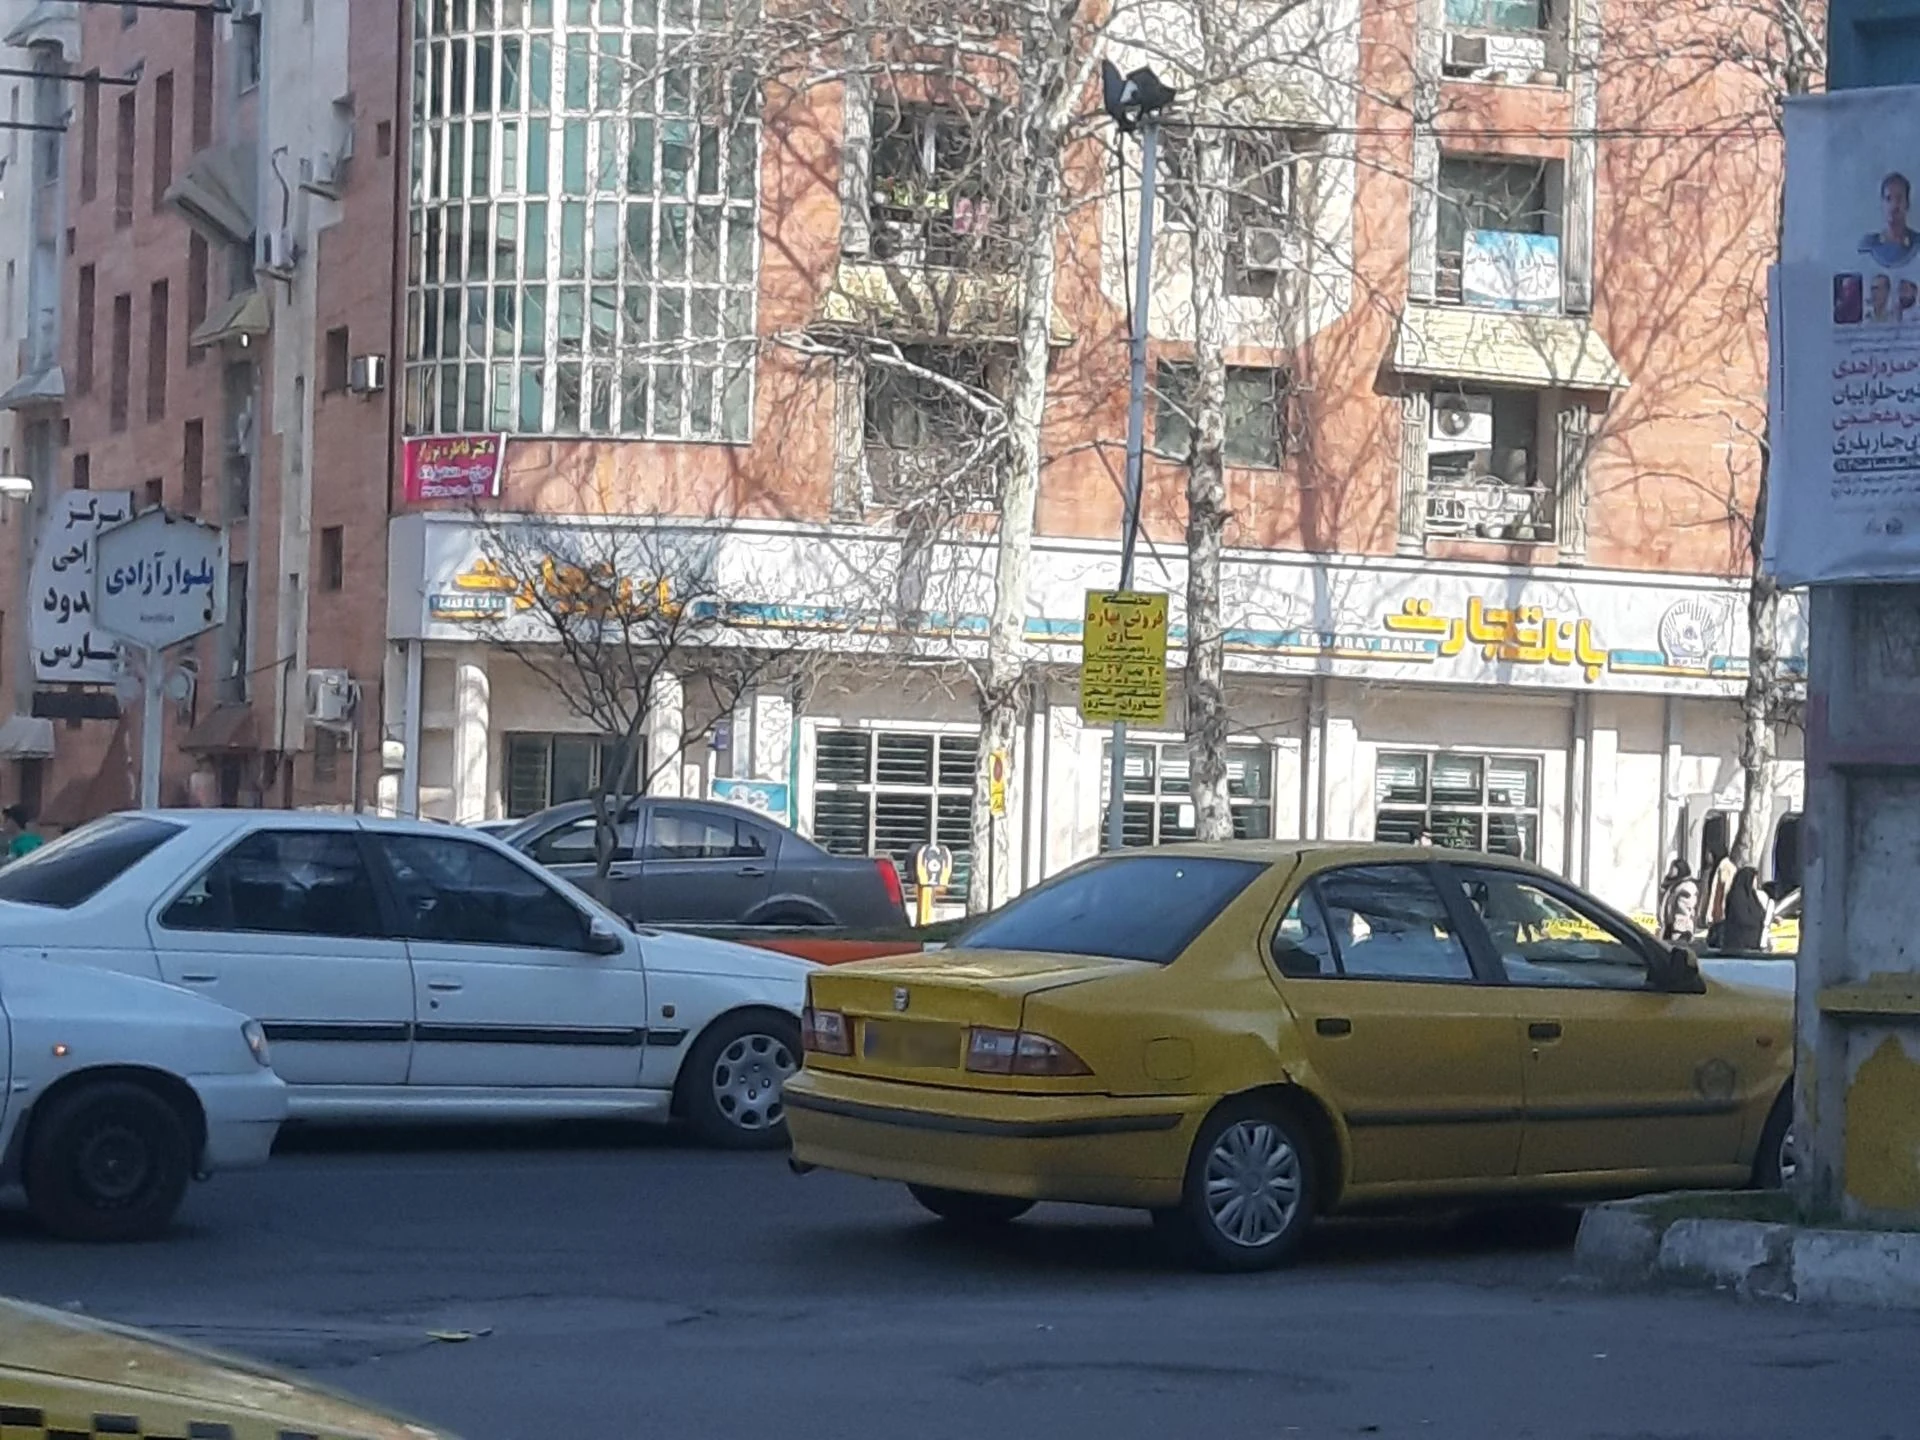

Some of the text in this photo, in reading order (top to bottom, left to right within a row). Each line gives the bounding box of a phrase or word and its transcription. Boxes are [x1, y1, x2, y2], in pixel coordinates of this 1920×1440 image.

[65, 498, 125, 530] مرکز
[106, 551, 215, 595] بلوار آزادی
[1299, 632, 1426, 653] TEJARAT BANK
[1384, 596, 1608, 682] بانک تجارت
